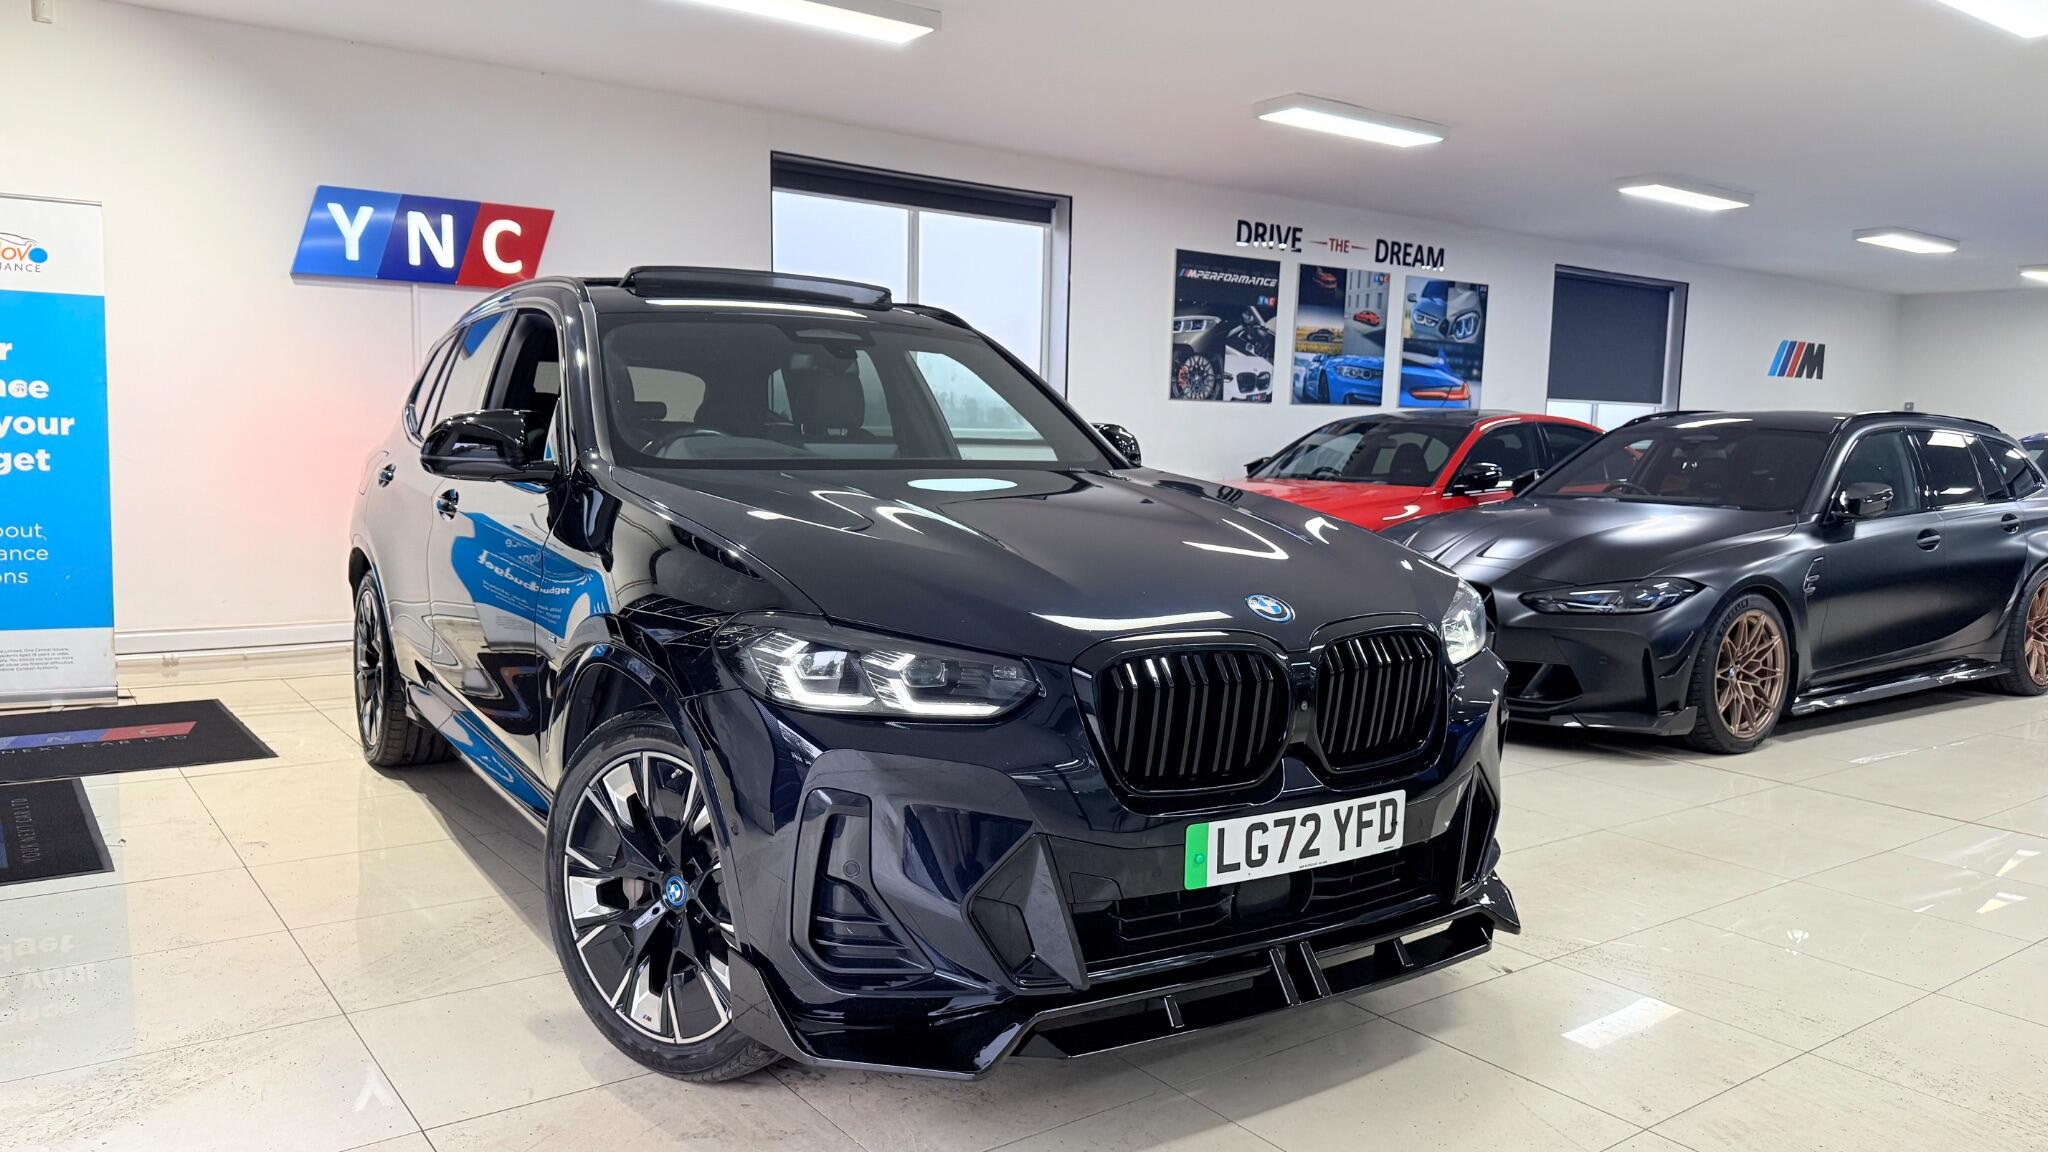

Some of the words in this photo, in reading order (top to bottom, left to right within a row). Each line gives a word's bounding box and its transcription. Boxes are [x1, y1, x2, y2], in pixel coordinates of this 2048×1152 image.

[327, 203, 523, 274] YNC
[1236, 219, 1303, 252] DRIVE
[1329, 238, 1350, 253] THE
[1375, 239, 1445, 270] DREAM
[1216, 812, 1322, 875] LG72
[1333, 797, 1398, 851] YFD
